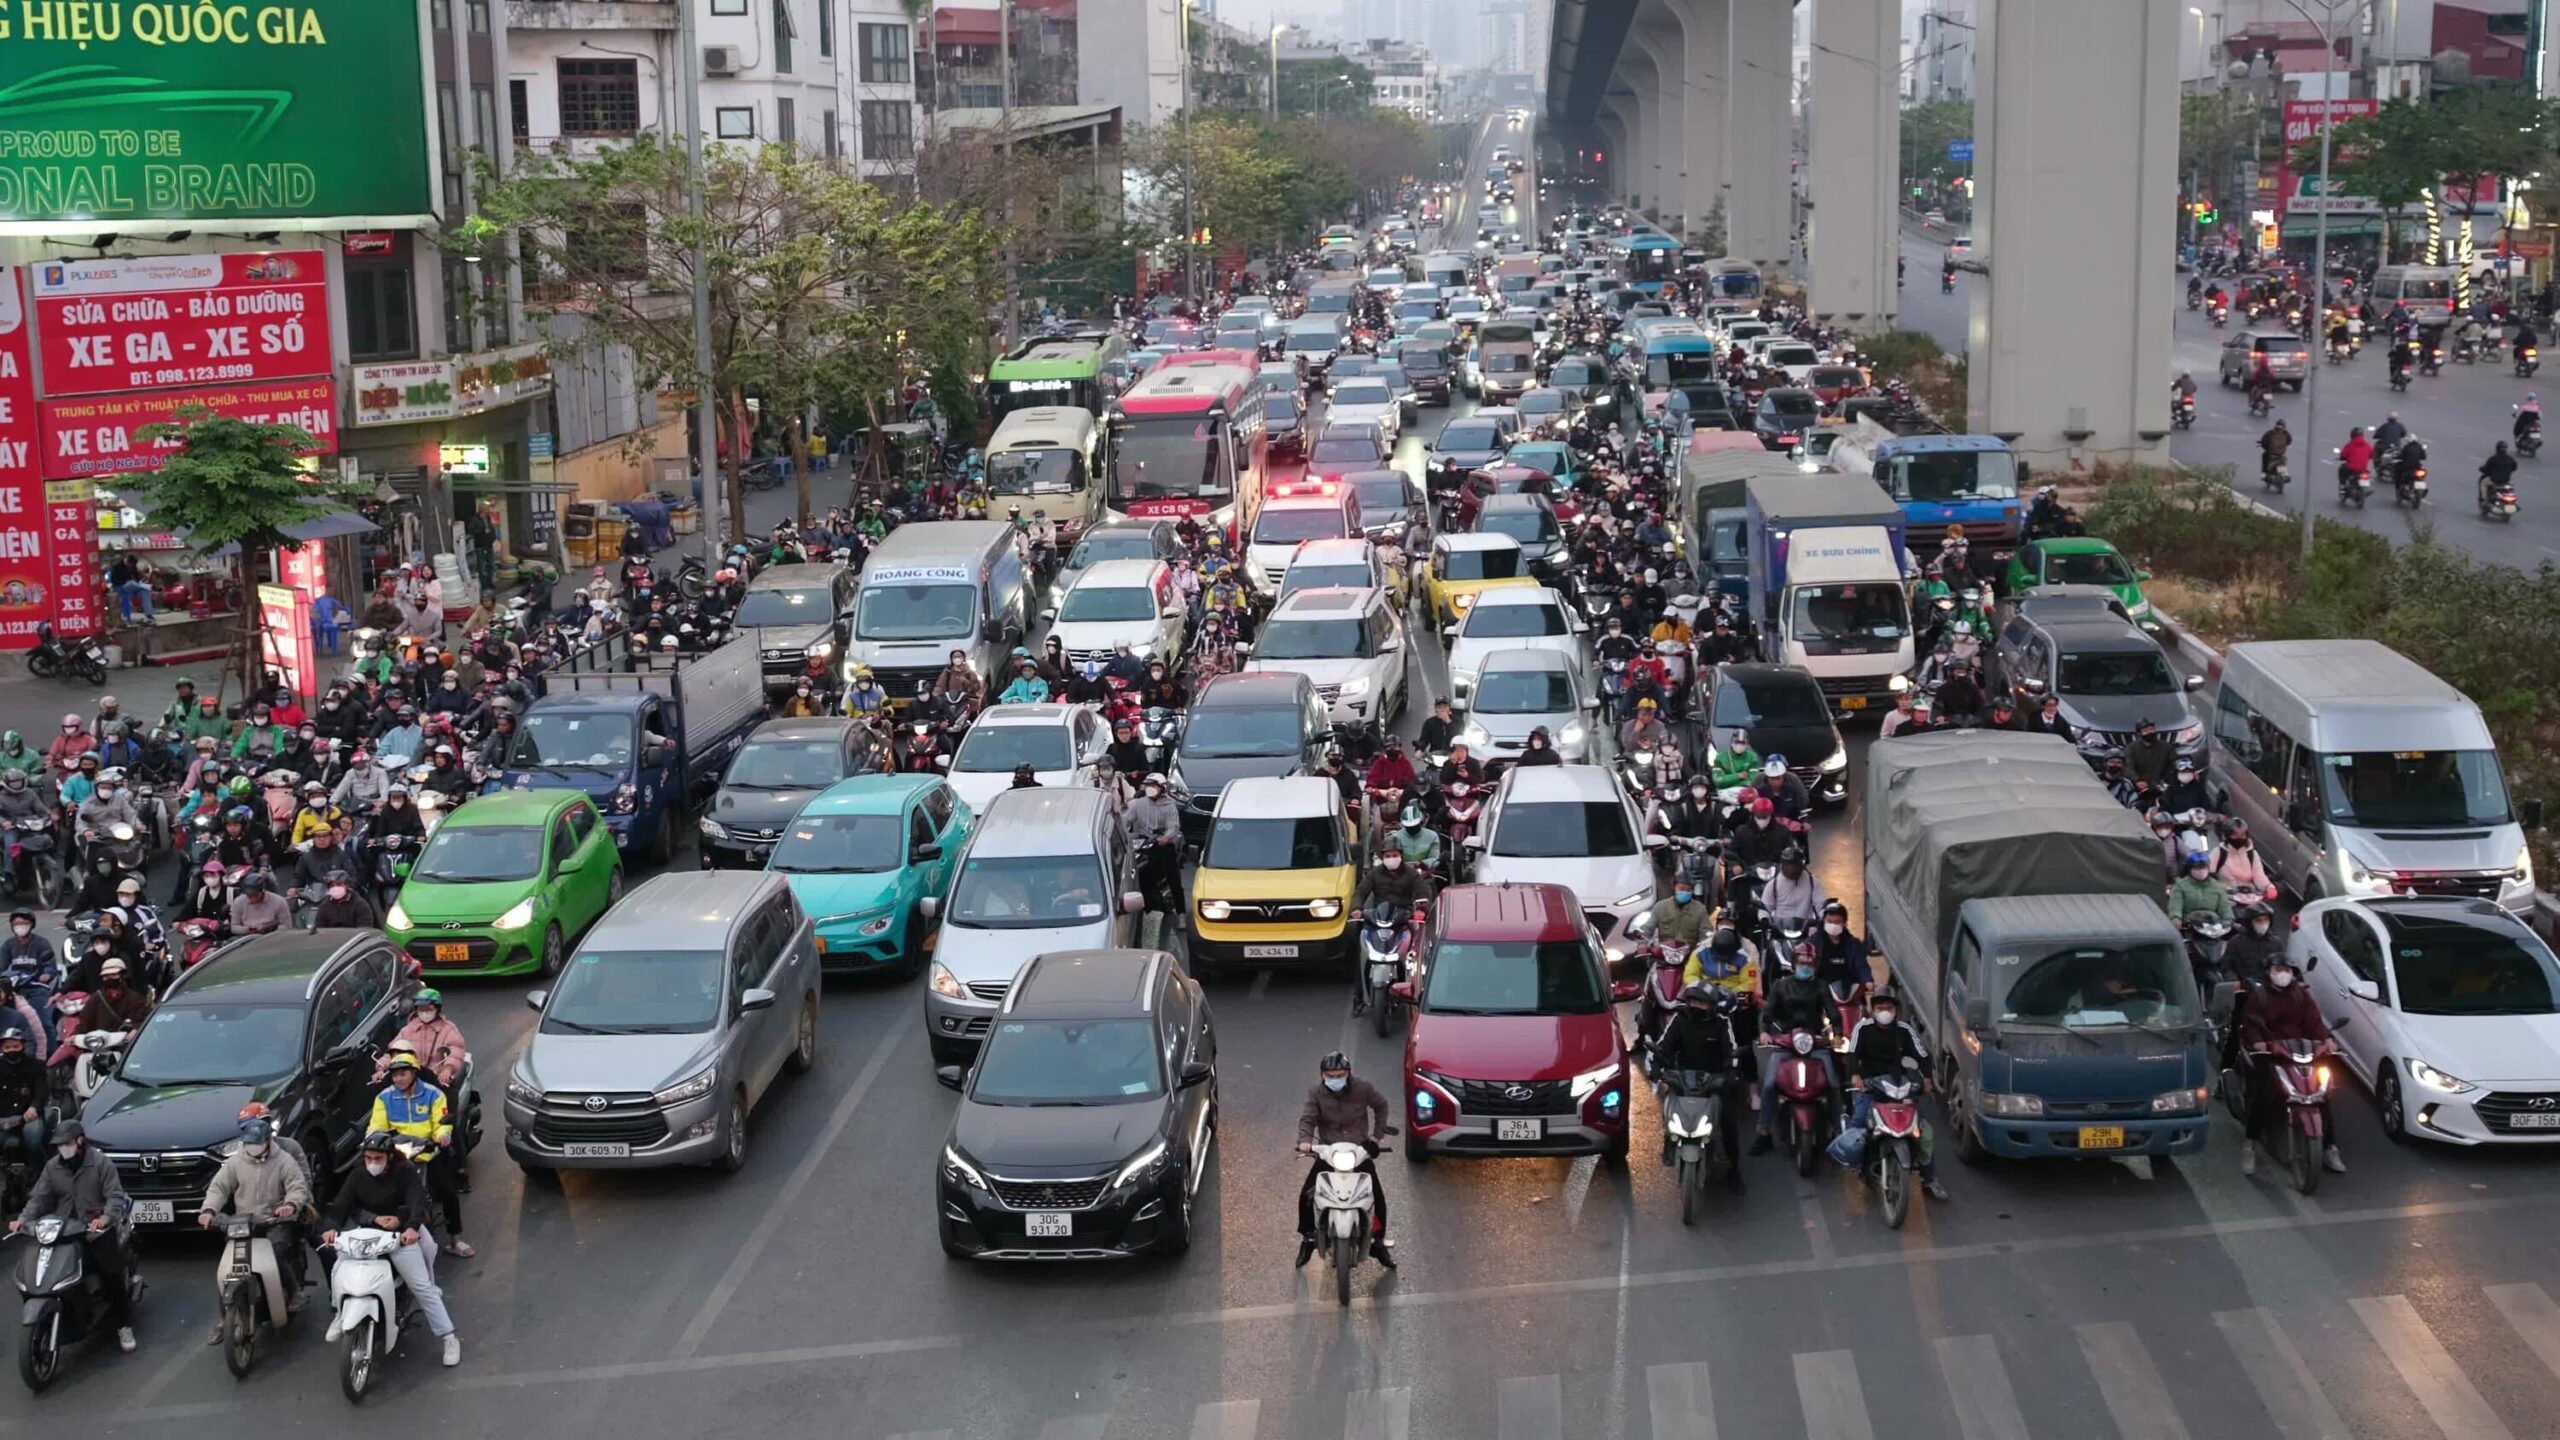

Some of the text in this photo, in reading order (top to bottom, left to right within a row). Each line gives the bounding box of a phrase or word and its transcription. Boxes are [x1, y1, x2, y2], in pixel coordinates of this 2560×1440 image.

[22, 0, 121, 50] HIỆU
[256, 7, 326, 44] GIA
[0, 130, 181, 158] PROUD TO BE
[145, 163, 316, 210] BRAND
[62, 299, 106, 326] SỬA
[112, 297, 169, 322] CHỮA
[189, 291, 230, 318] BẢO
[236, 289, 305, 315] DƯỠNG
[67, 335, 114, 368] XE
[125, 331, 173, 364] GA
[206, 327, 250, 358] XE
[260, 313, 305, 354] SỐ
[130, 363, 254, 385] ĐT: 098.123.8999
[54, 406, 95, 418] TRUNG
[97, 402, 122, 415] TÂM
[208, 393, 238, 407] CHỮA
[246, 392, 269, 404] THU
[271, 390, 293, 401] MUA
[296, 389, 310, 399] XE
[57, 429, 89, 456] XE
[96, 426, 129, 453] GA
[54, 509, 77, 521] XE
[1147, 506, 1159, 514] XE
[55, 528, 80, 541] GA
[58, 554, 82, 566] XE
[60, 569, 82, 586] SỐ
[62, 598, 85, 611] XE
[60, 614, 90, 632] ĐIỆN
[1511, 1121, 1528, 1129] 36A
[142, 1203, 160, 1212] 30G
[1040, 1215, 1059, 1224] 30G
[1031, 1225, 1068, 1235] 931.20
